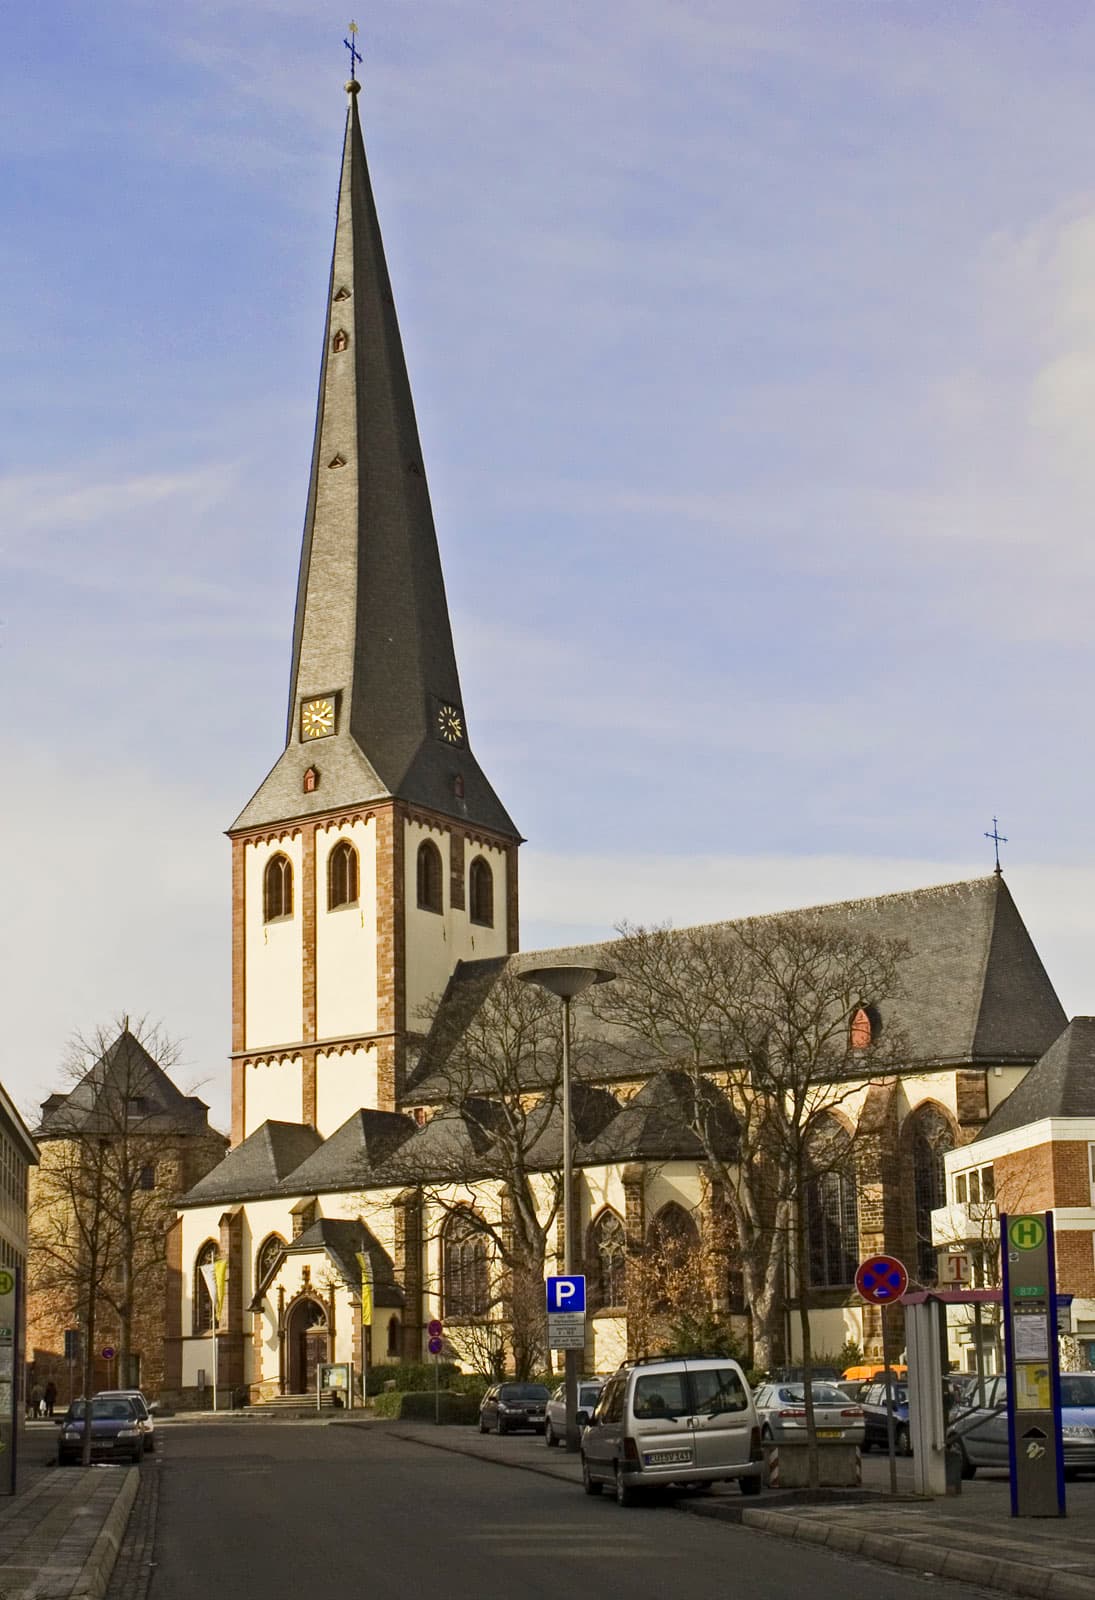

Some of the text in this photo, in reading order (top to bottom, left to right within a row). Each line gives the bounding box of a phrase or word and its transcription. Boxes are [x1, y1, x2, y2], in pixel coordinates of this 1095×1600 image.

[1018, 1224, 1036, 1244] H
[948, 1256, 968, 1280] T
[556, 1281, 575, 1307] P
